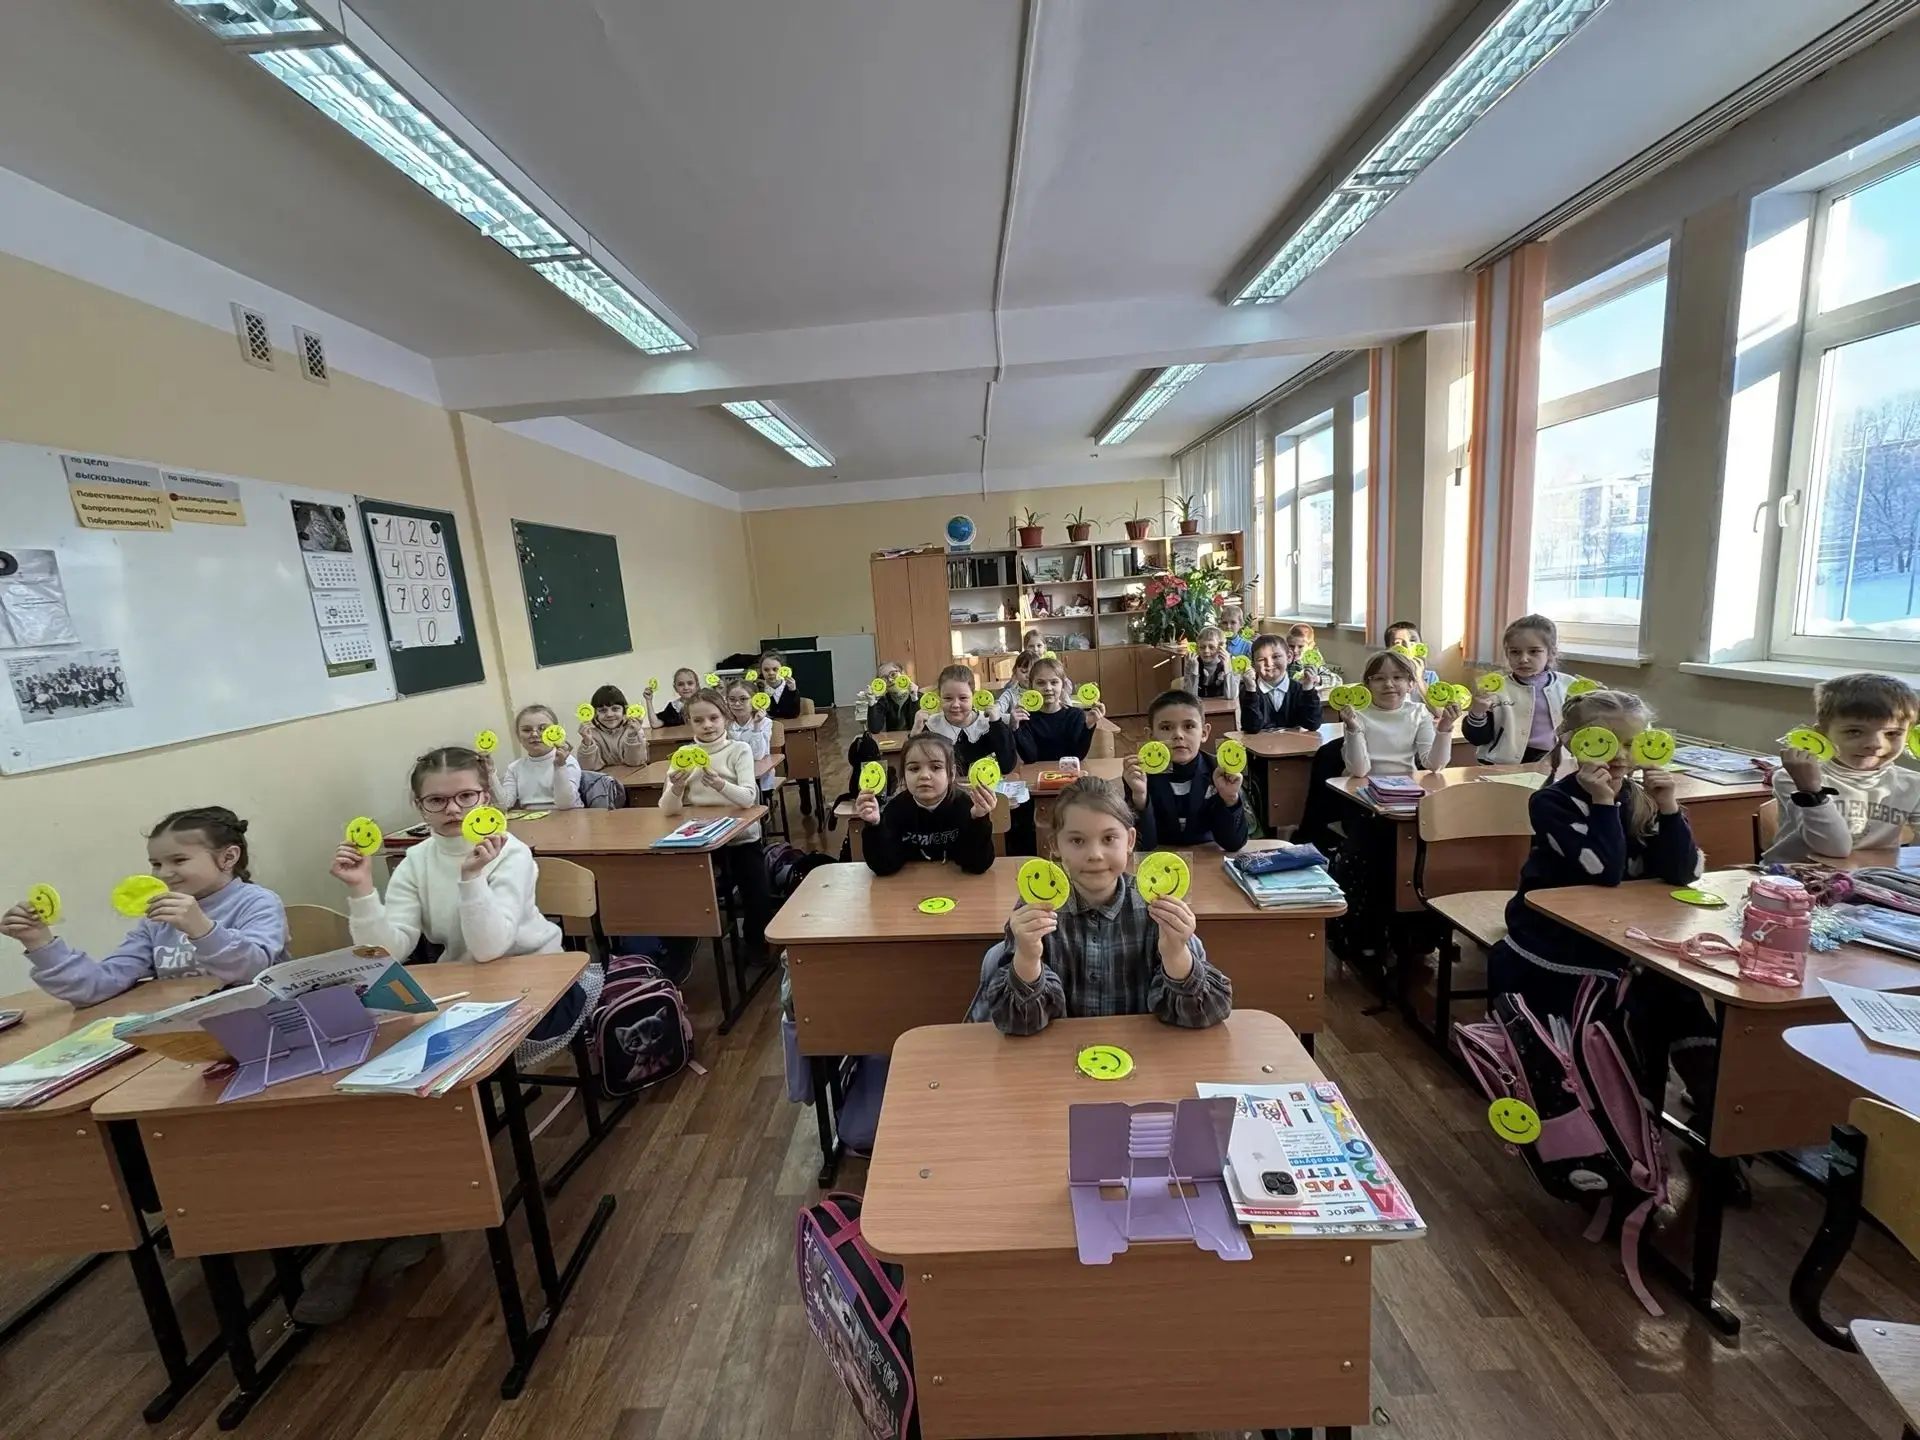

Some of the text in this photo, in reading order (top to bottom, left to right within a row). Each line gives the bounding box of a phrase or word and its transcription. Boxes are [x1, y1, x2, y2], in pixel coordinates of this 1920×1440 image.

[83, 457, 109, 467] цели
[75, 472, 150, 487] высказывания:
[385, 518, 392, 541] 1
[407, 520, 418, 543] 2
[391, 553, 446, 577] 4 5 6
[396, 587, 451, 611] 7 8 9
[427, 620, 437, 643] 0
[281, 961, 385, 994] Математика
[383, 979, 420, 1006] 1
[1301, 1179, 1353, 1193] РАБ
